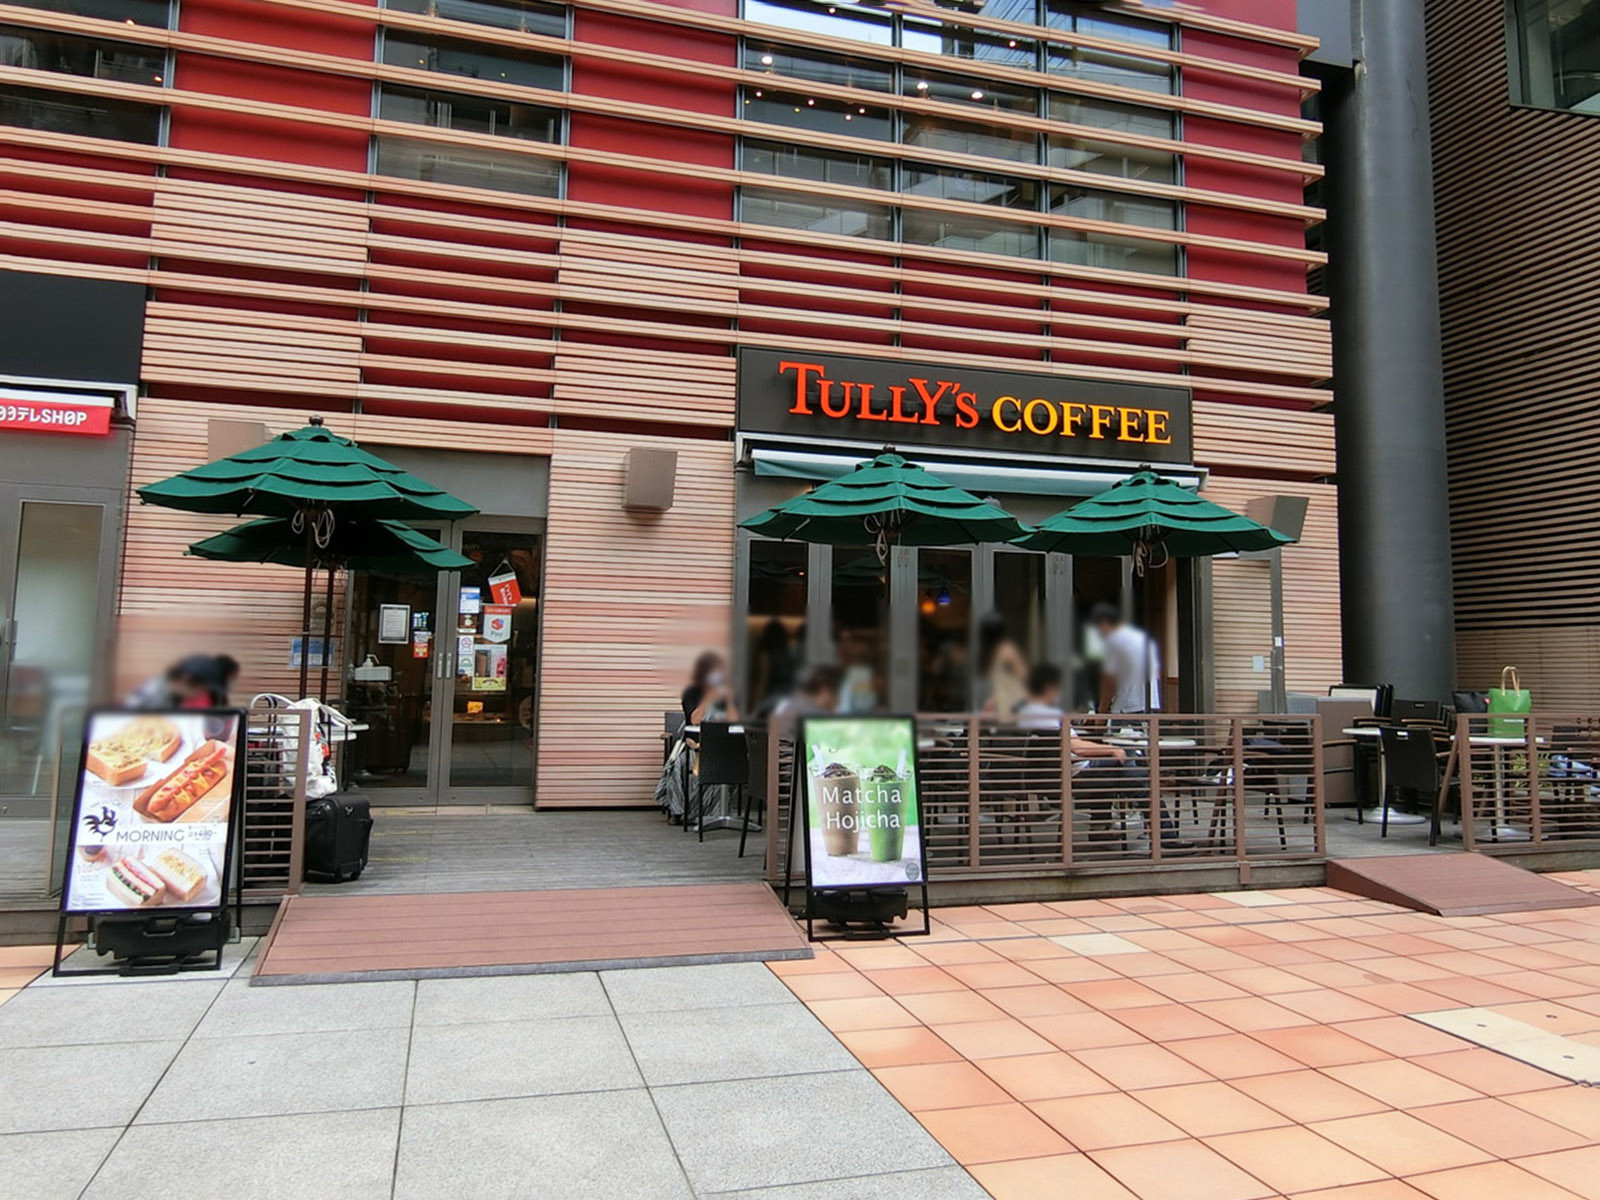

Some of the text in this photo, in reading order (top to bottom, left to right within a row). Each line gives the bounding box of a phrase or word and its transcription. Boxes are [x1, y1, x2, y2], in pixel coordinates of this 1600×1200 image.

[778, 360, 1172, 445] TULLY'S COFFEE
[822, 784, 903, 804] Matcha
[826, 809, 901, 833] Hojicha
[115, 829, 186, 843] MORNING
